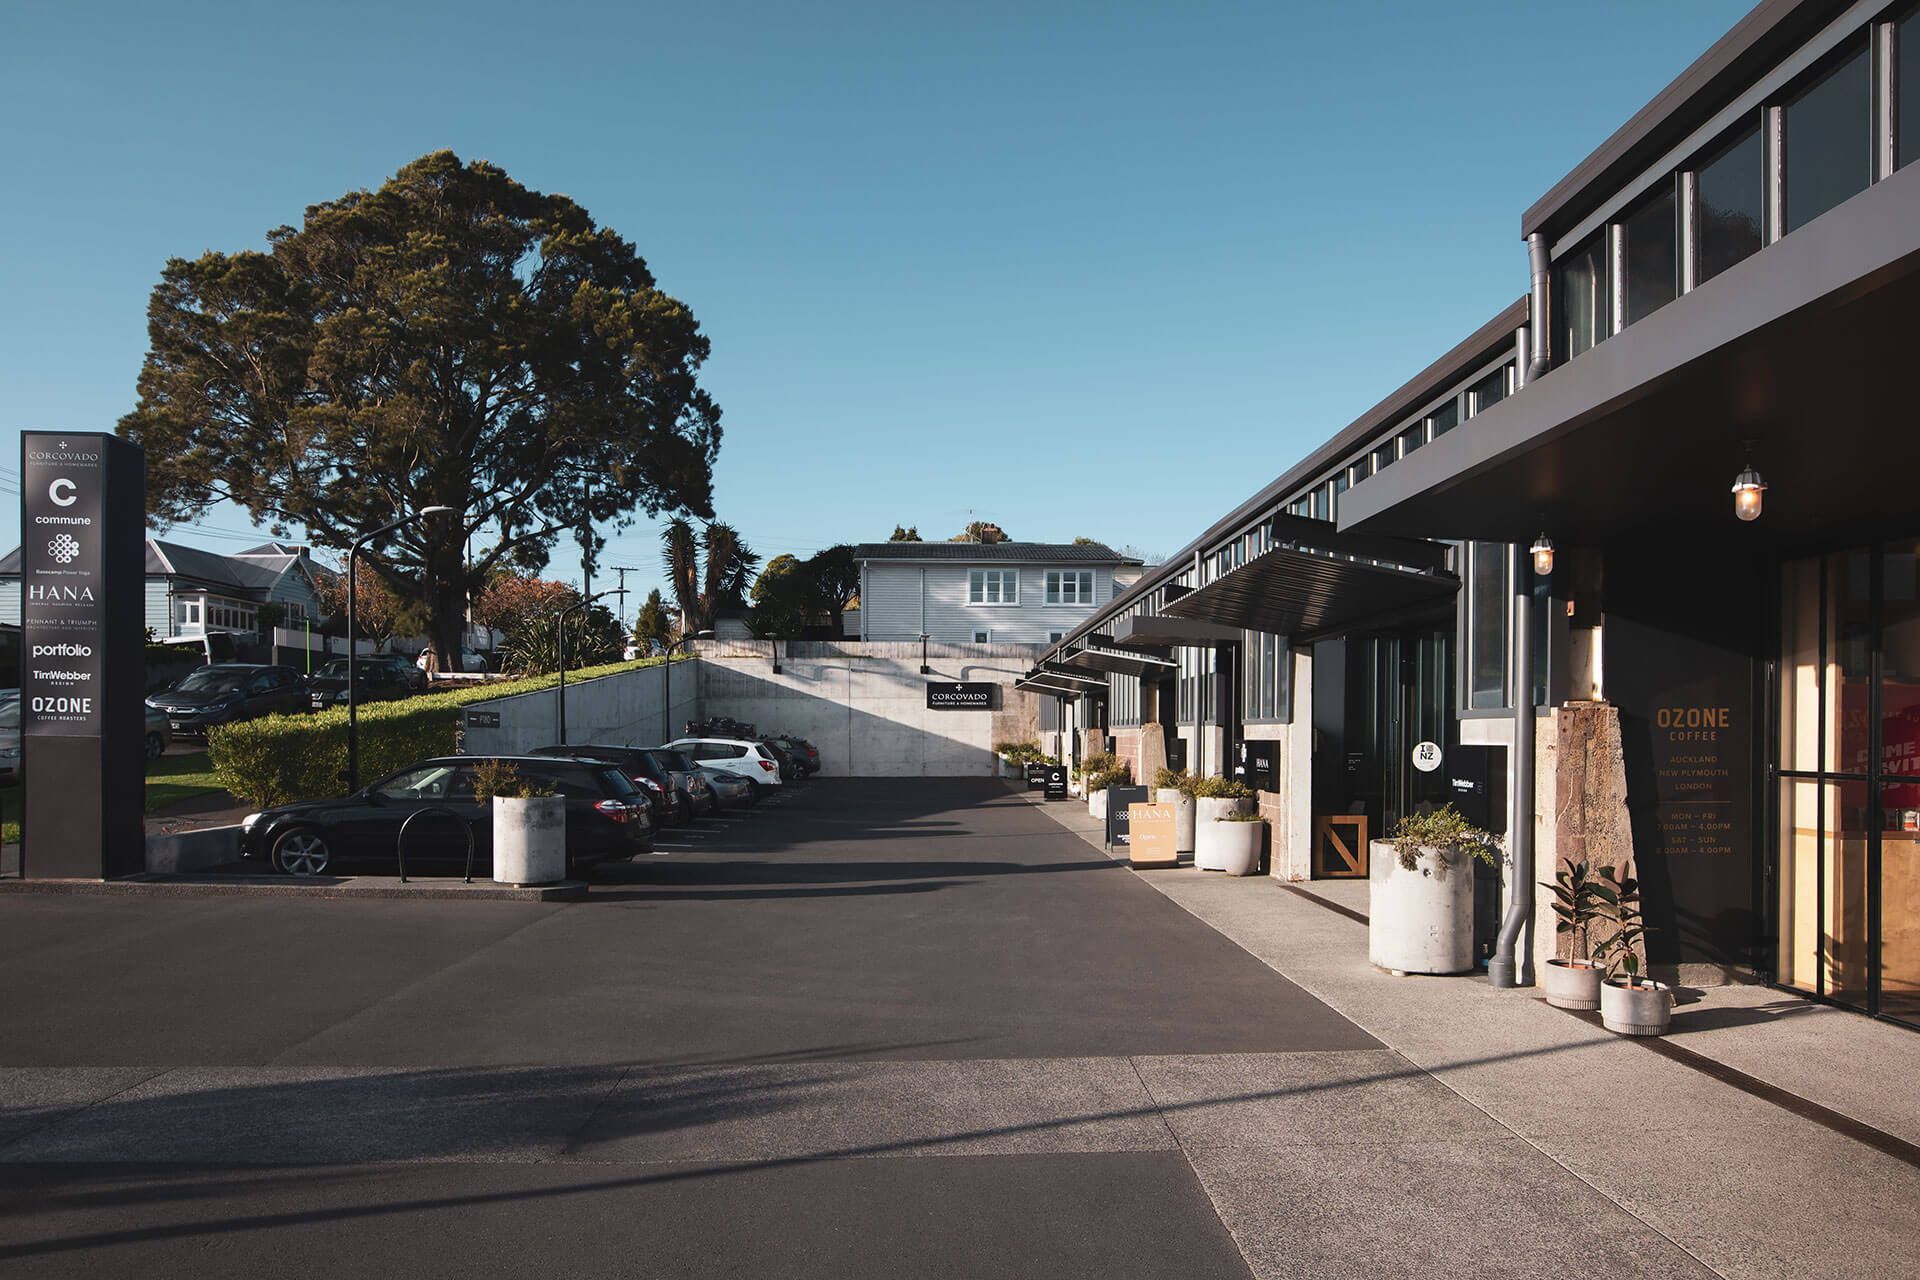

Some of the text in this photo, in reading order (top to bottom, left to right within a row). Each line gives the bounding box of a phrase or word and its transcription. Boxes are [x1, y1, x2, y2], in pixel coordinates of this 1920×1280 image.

[29, 451, 98, 461] CORCOVADO
[48, 478, 77, 507] C
[35, 516, 91, 525] commune
[30, 584, 94, 601] HANA
[33, 643, 92, 658] portfolio
[33, 670, 92, 680] TimWebber
[32, 697, 92, 713] OZONE
[1657, 708, 1729, 728] OZONE
[1669, 731, 1718, 741] COFFEE
[1420, 752, 1434, 760] NZ
[1670, 755, 1718, 764] AUCKLAND
[1658, 768, 1729, 777] NEW PLYMOUTH
[1674, 783, 1713, 791] LONDON
[1132, 808, 1171, 819] HANA
[1671, 812, 1692, 820] MON
[1701, 812, 1717, 820] FRI
